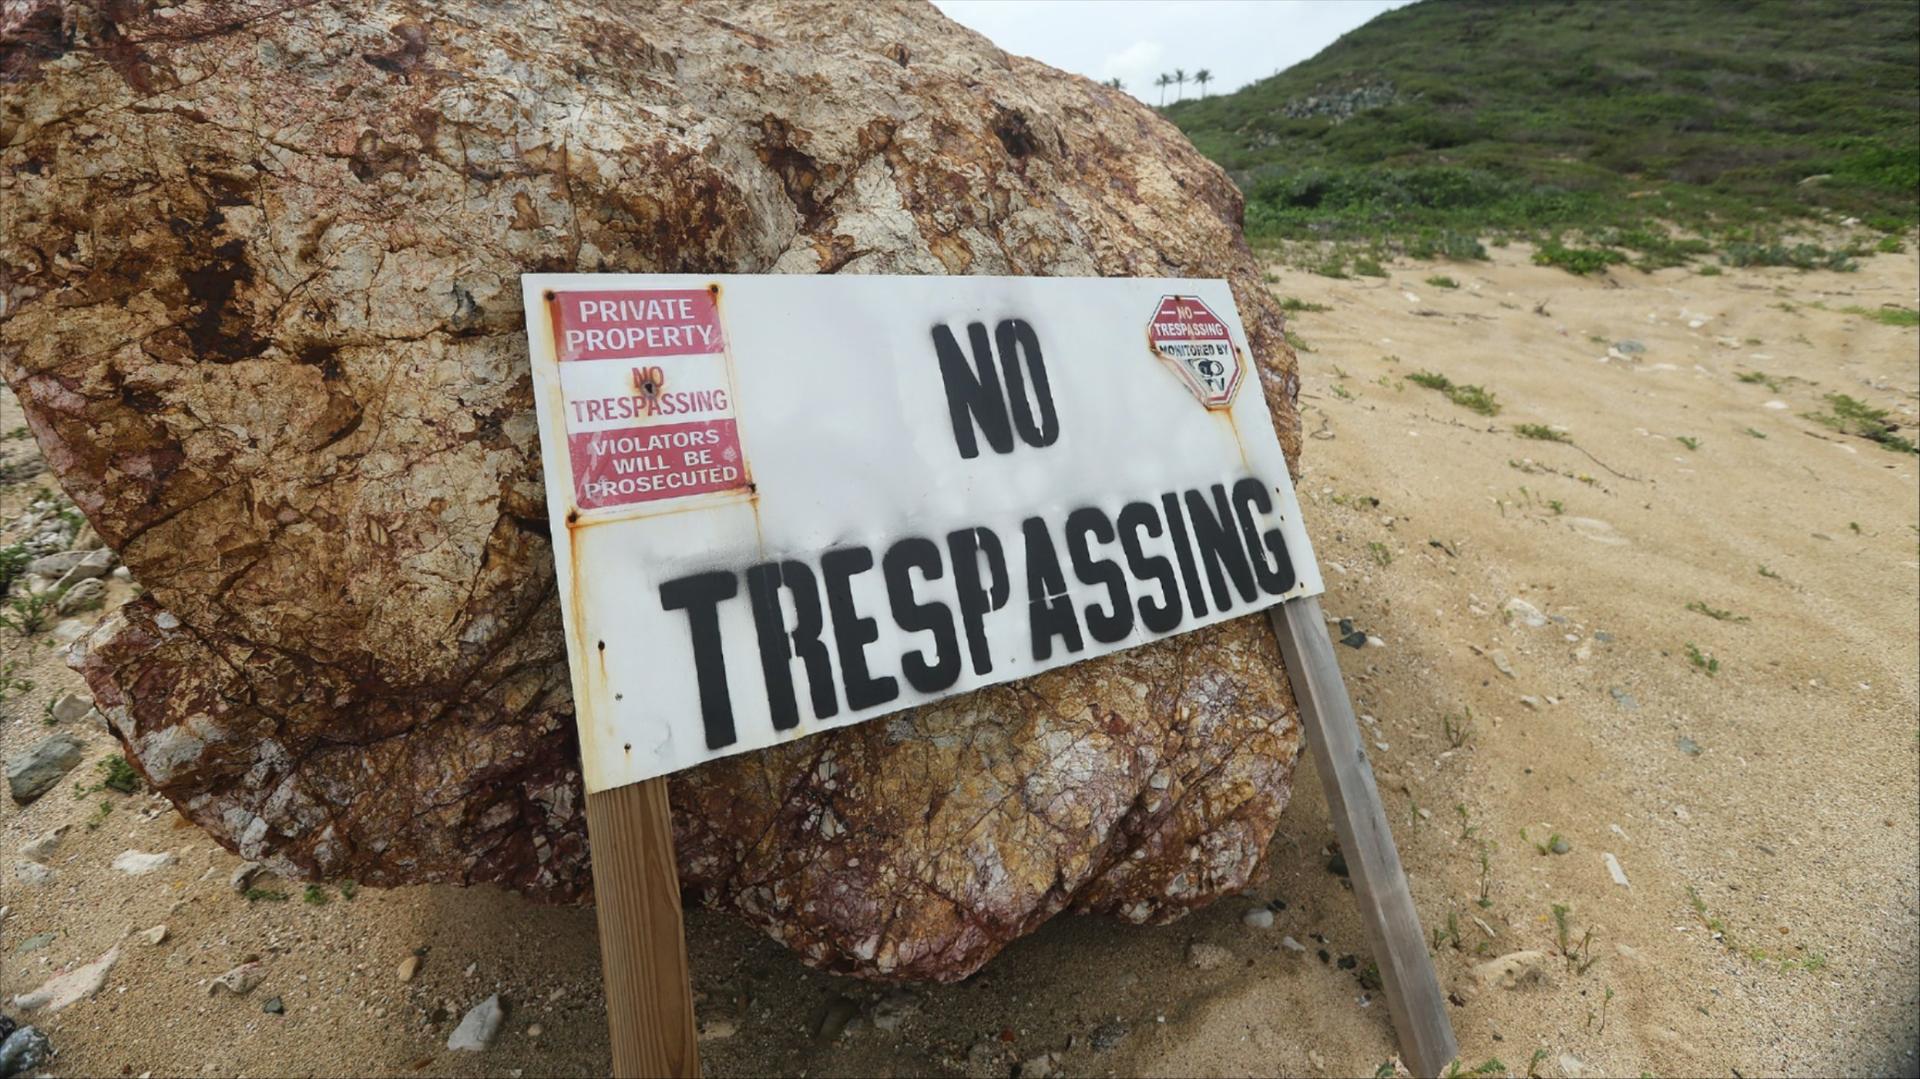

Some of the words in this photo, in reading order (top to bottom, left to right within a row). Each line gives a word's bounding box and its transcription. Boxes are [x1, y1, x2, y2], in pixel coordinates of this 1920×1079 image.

[579, 299, 695, 322] PRIVATE
[1176, 306, 1193, 319] NO
[565, 325, 713, 351] PROPERTY
[1154, 323, 1224, 336] TRESPASSING
[1216, 344, 1229, 355] BY
[632, 366, 664, 388] NO
[932, 319, 1060, 459] NO
[571, 389, 728, 422] TRESPASSING
[593, 429, 720, 455] VIOLATORS
[613, 455, 670, 474] WILL
[684, 449, 714, 466] BE
[584, 466, 738, 498] PROSECUTED
[660, 477, 1296, 750] TRESPASSING
